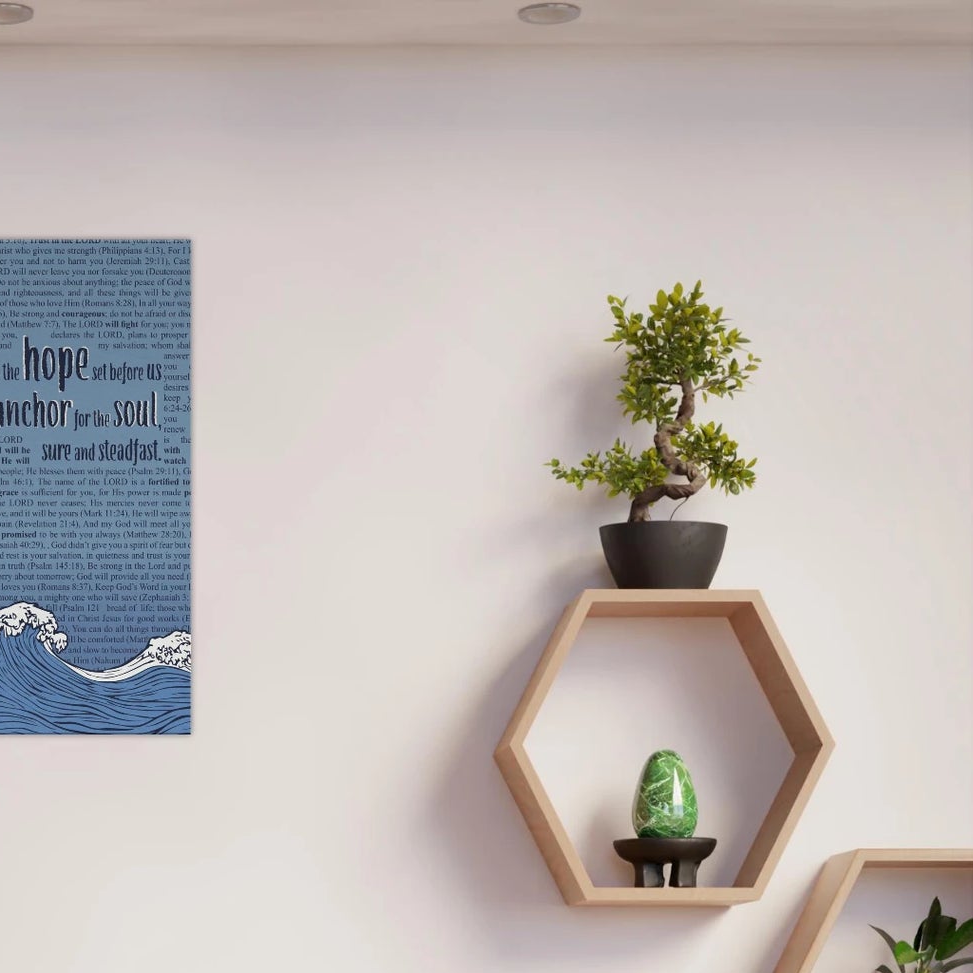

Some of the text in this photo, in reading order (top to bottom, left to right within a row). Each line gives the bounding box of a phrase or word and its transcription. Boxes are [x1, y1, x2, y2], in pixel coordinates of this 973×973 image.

[119, 289, 142, 299] things
[1, 362, 20, 381] the
[23, 335, 90, 391] hope
[92, 364, 107, 381] set
[109, 362, 144, 384] before
[147, 364, 162, 381] us
[74, 409, 90, 430] for
[93, 408, 110, 428] the
[113, 392, 162, 431] soul,
[41, 439, 162, 465] sure and steadfast.
[1, 530, 38, 539] promised
[96, 530, 121, 539] always
